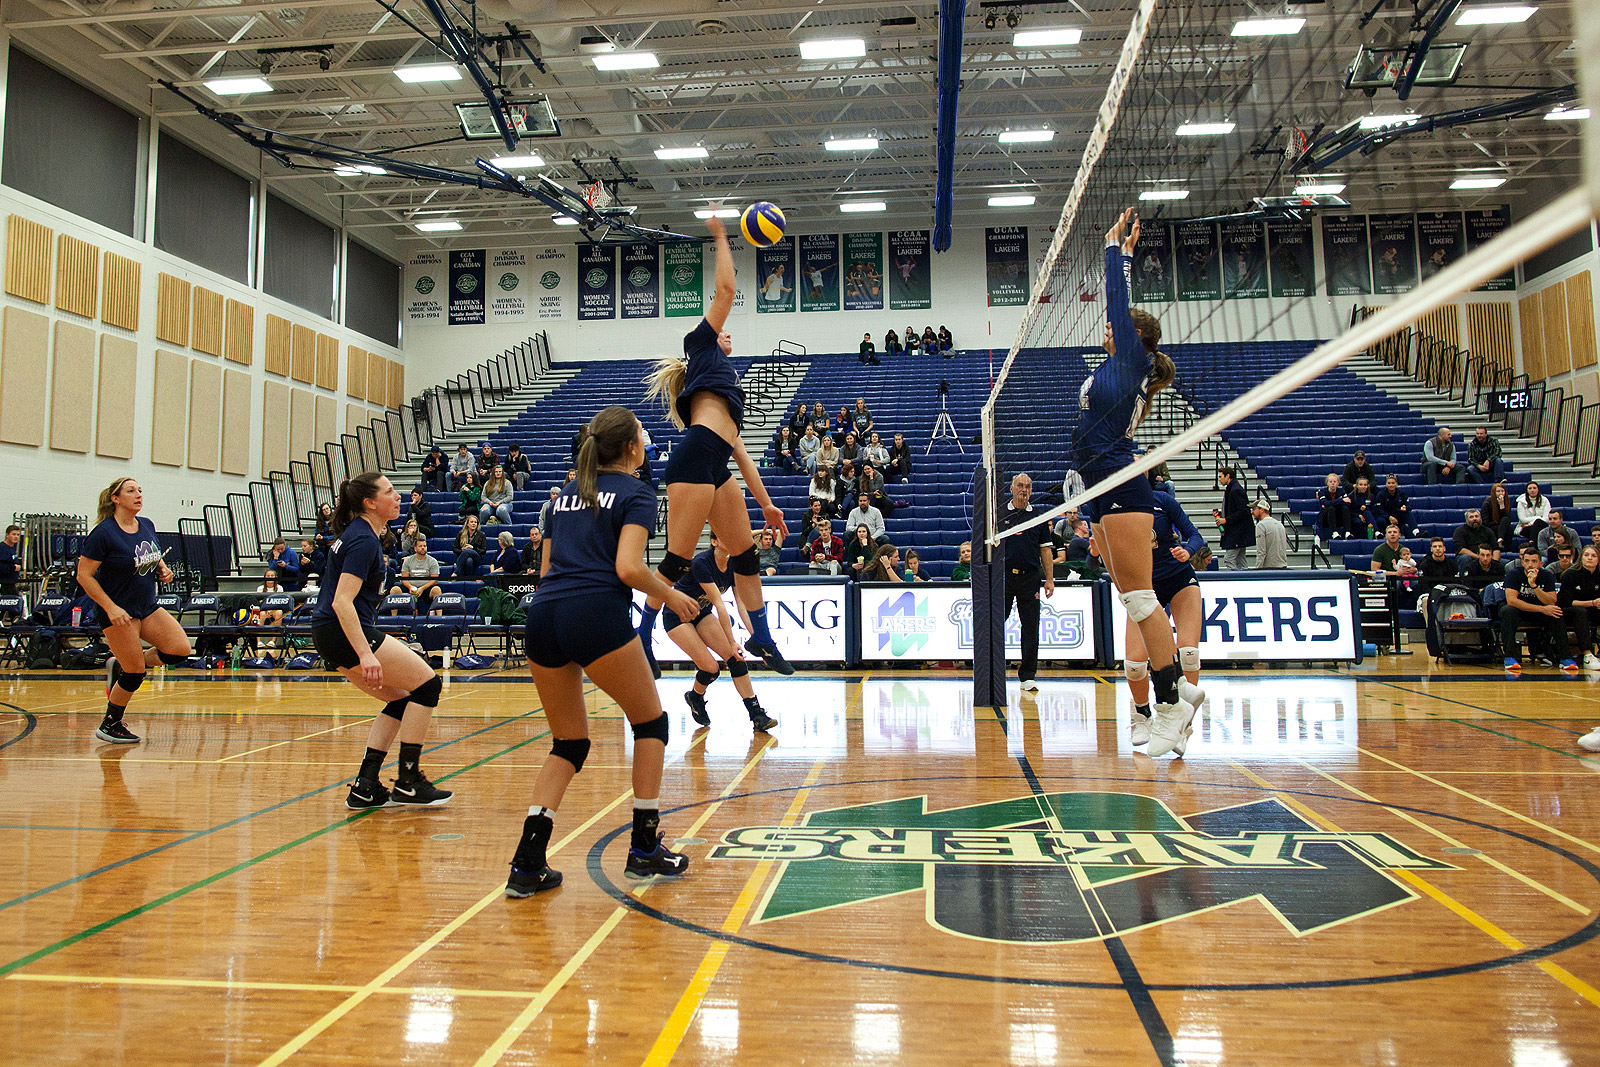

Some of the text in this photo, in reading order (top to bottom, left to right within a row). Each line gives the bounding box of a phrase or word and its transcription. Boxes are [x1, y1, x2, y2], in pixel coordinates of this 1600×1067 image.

[508, 583, 535, 594] sports
[191, 597, 215, 605] LAKERS
[265, 597, 290, 605] LAKERS
[387, 596, 411, 605] LAKERS
[437, 596, 461, 604] LAKERS
[1199, 596, 1340, 642] KERS
[871, 616, 936, 634] LAKERS
[704, 824, 1466, 871] LAKERS
